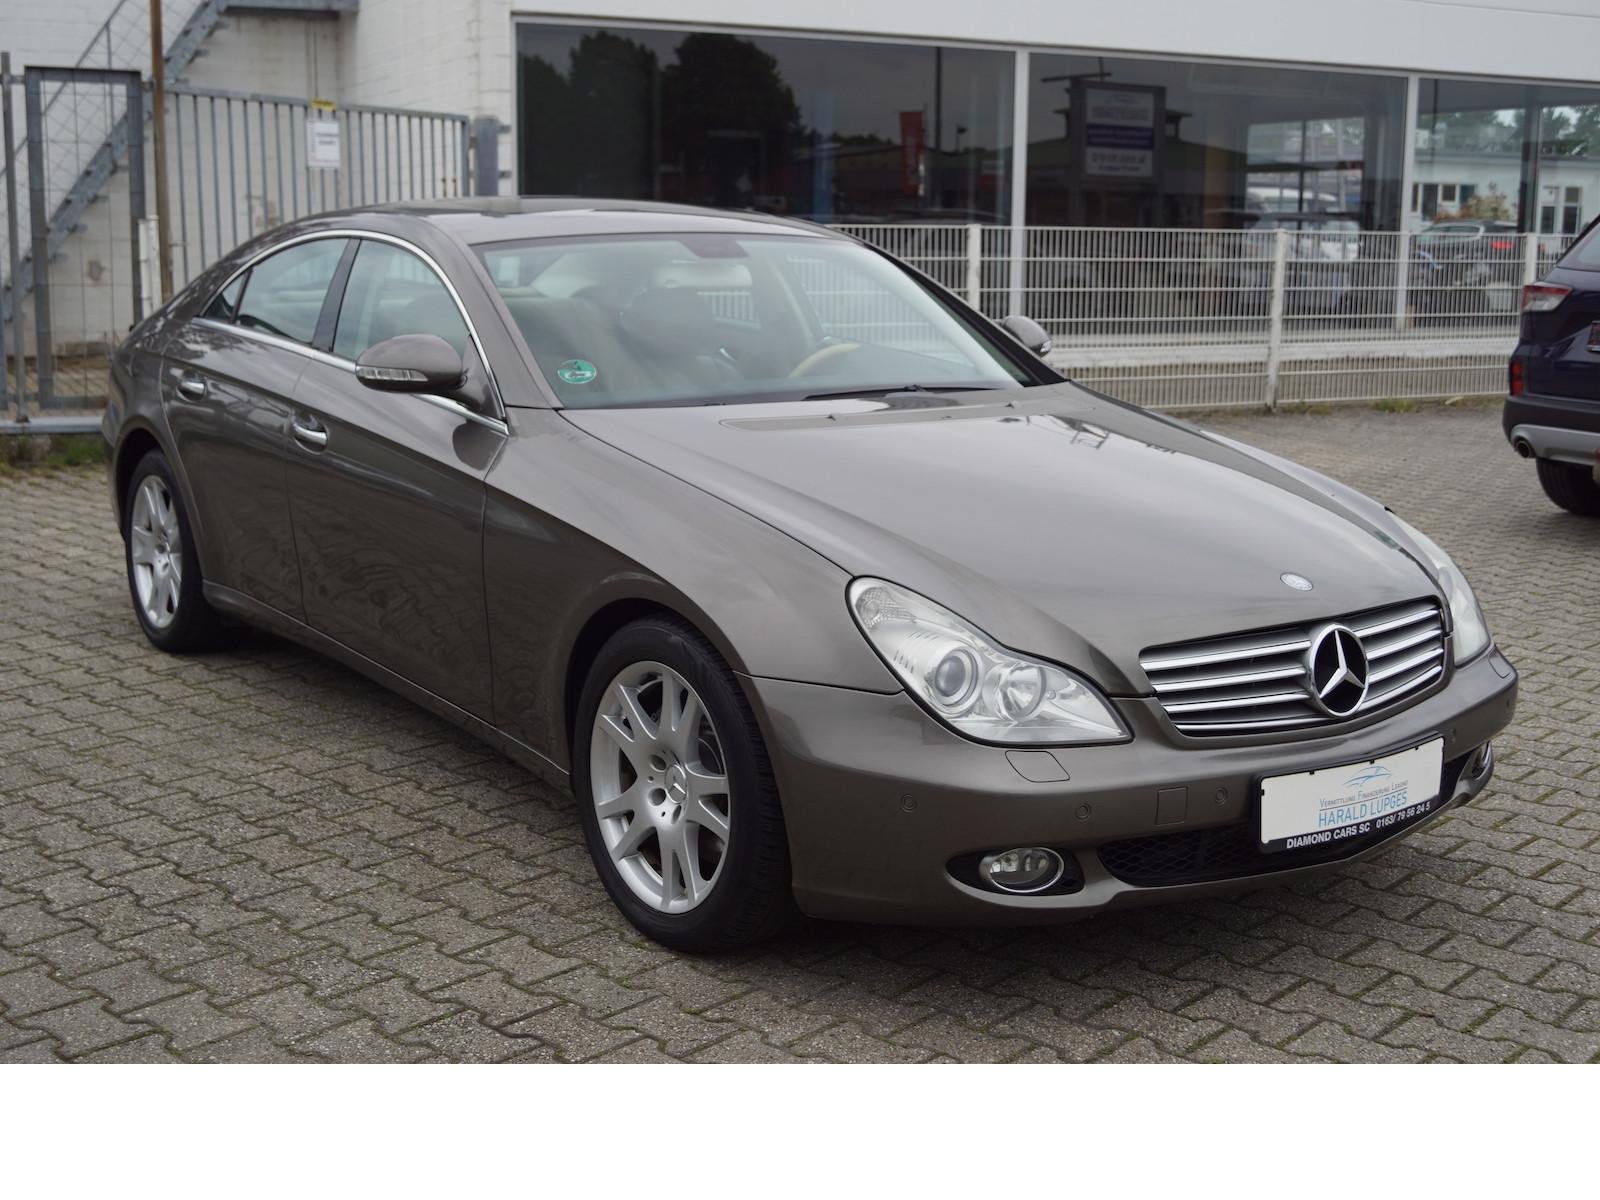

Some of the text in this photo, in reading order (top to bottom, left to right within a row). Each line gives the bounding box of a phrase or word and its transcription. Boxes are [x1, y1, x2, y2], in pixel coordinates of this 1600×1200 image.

[1286, 801, 1431, 849] DIAMOND CARS SC 0163/ 79 56 24 5
[1318, 804, 1368, 828] HARALD
